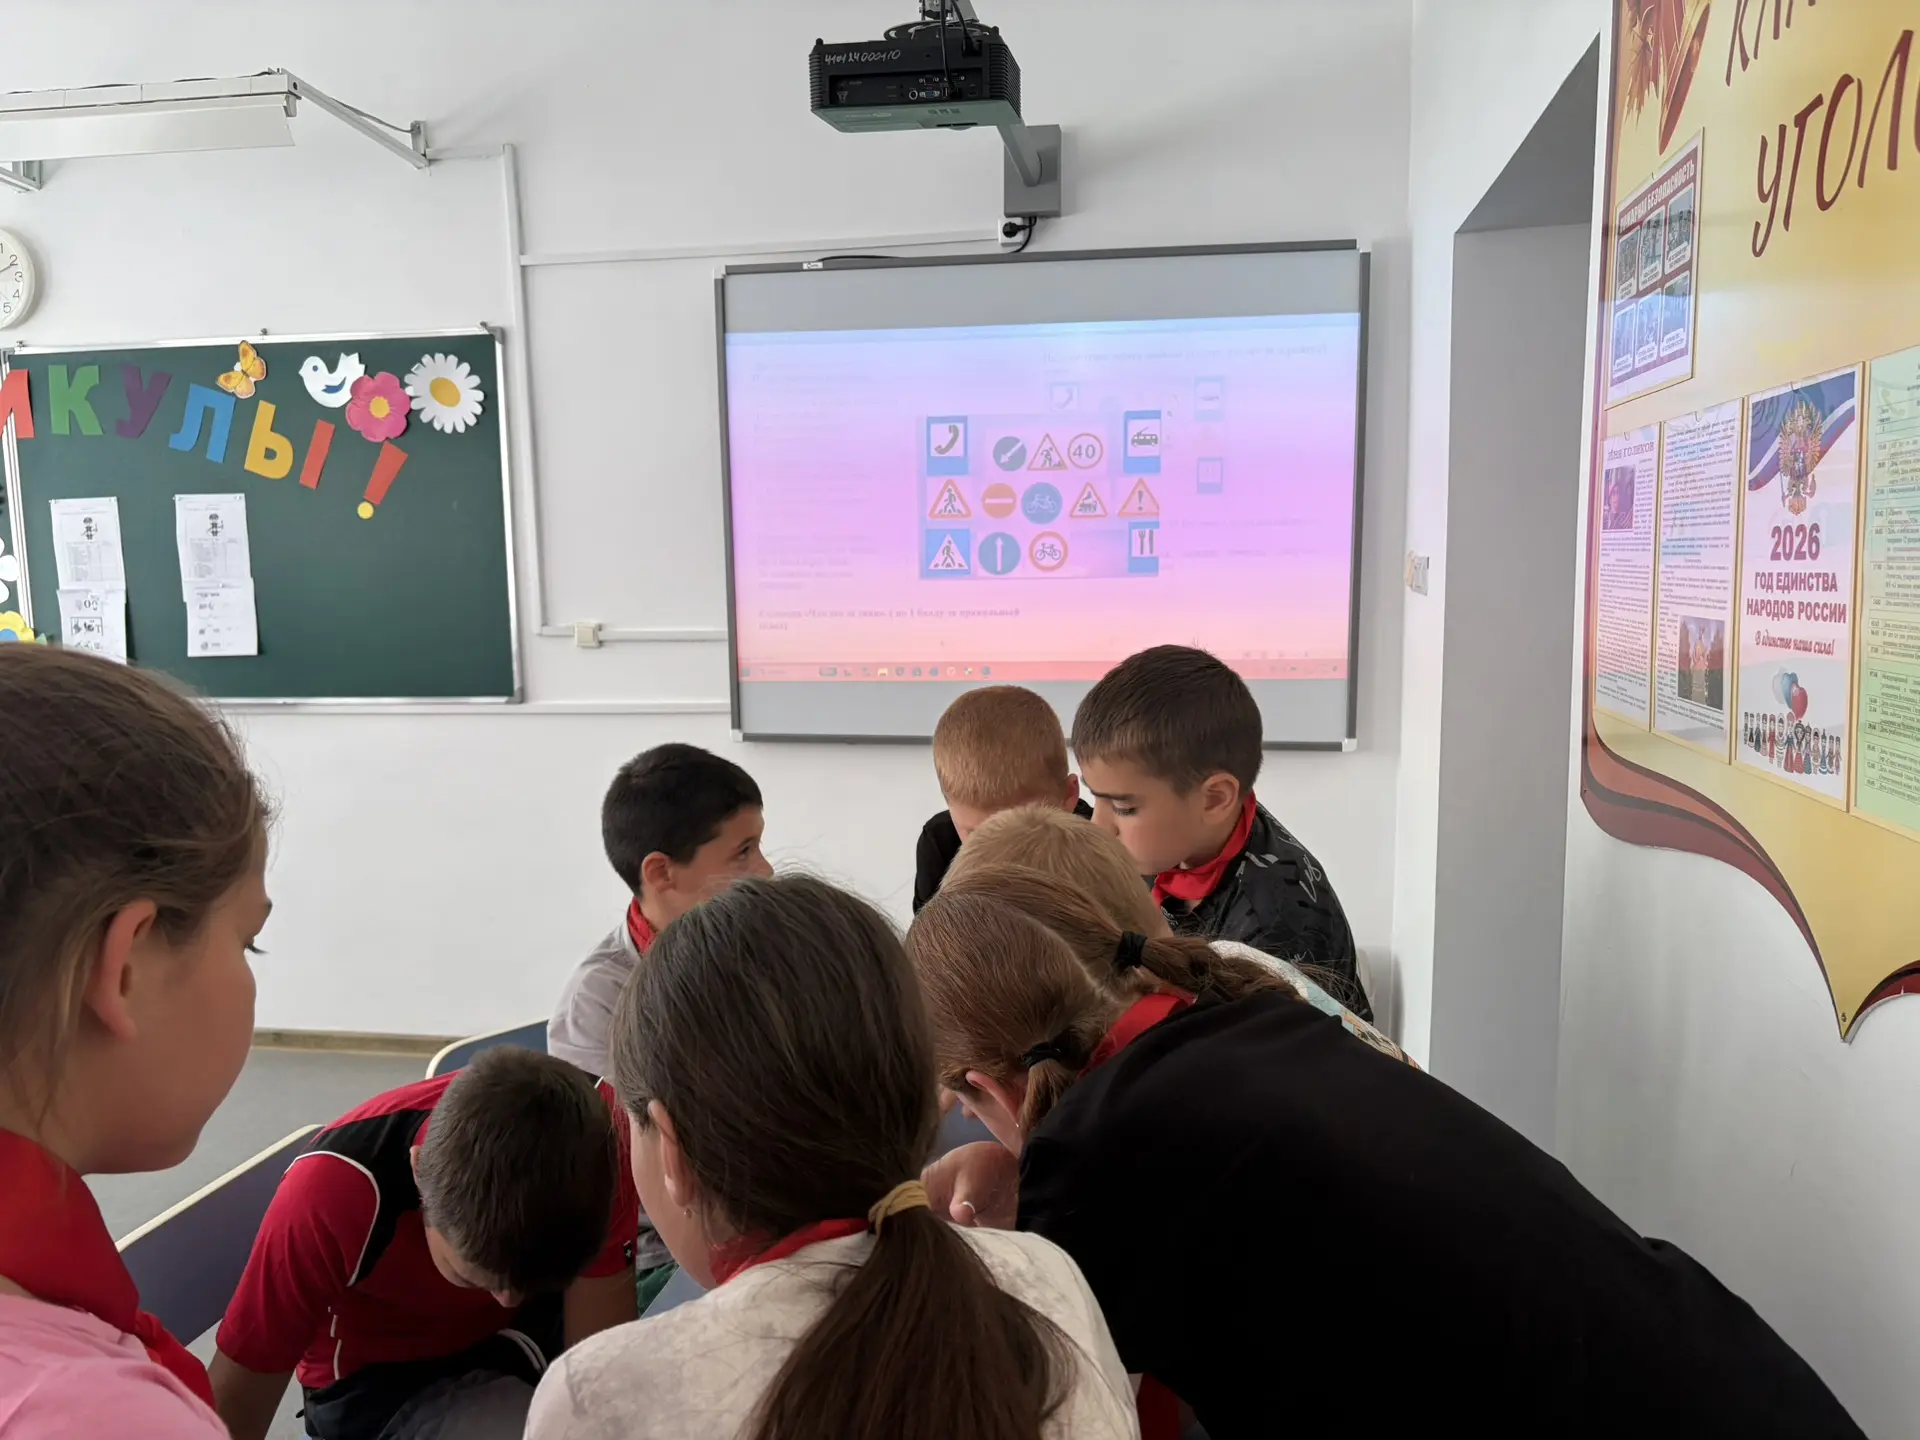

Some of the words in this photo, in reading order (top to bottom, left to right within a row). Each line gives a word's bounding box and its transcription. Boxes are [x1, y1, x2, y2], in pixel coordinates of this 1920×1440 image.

[1752, 30, 1920, 258] УГОЛ
[9, 254, 18, 267] 2
[14, 271, 23, 283] 3
[12, 288, 20, 298] 4
[3, 302, 12, 314] 5
[1072, 444, 1096, 459] 40
[1770, 522, 1820, 561] 2026
[1754, 571, 1774, 594] ГОД
[1776, 572, 1838, 594] ЕДИНСТВА
[1746, 598, 1795, 621] НАРОДОВ
[1797, 601, 1847, 624] РОССИИ
[1754, 630, 1762, 646] В
[1793, 638, 1812, 653] наша
[1813, 638, 1836, 656] сила!
